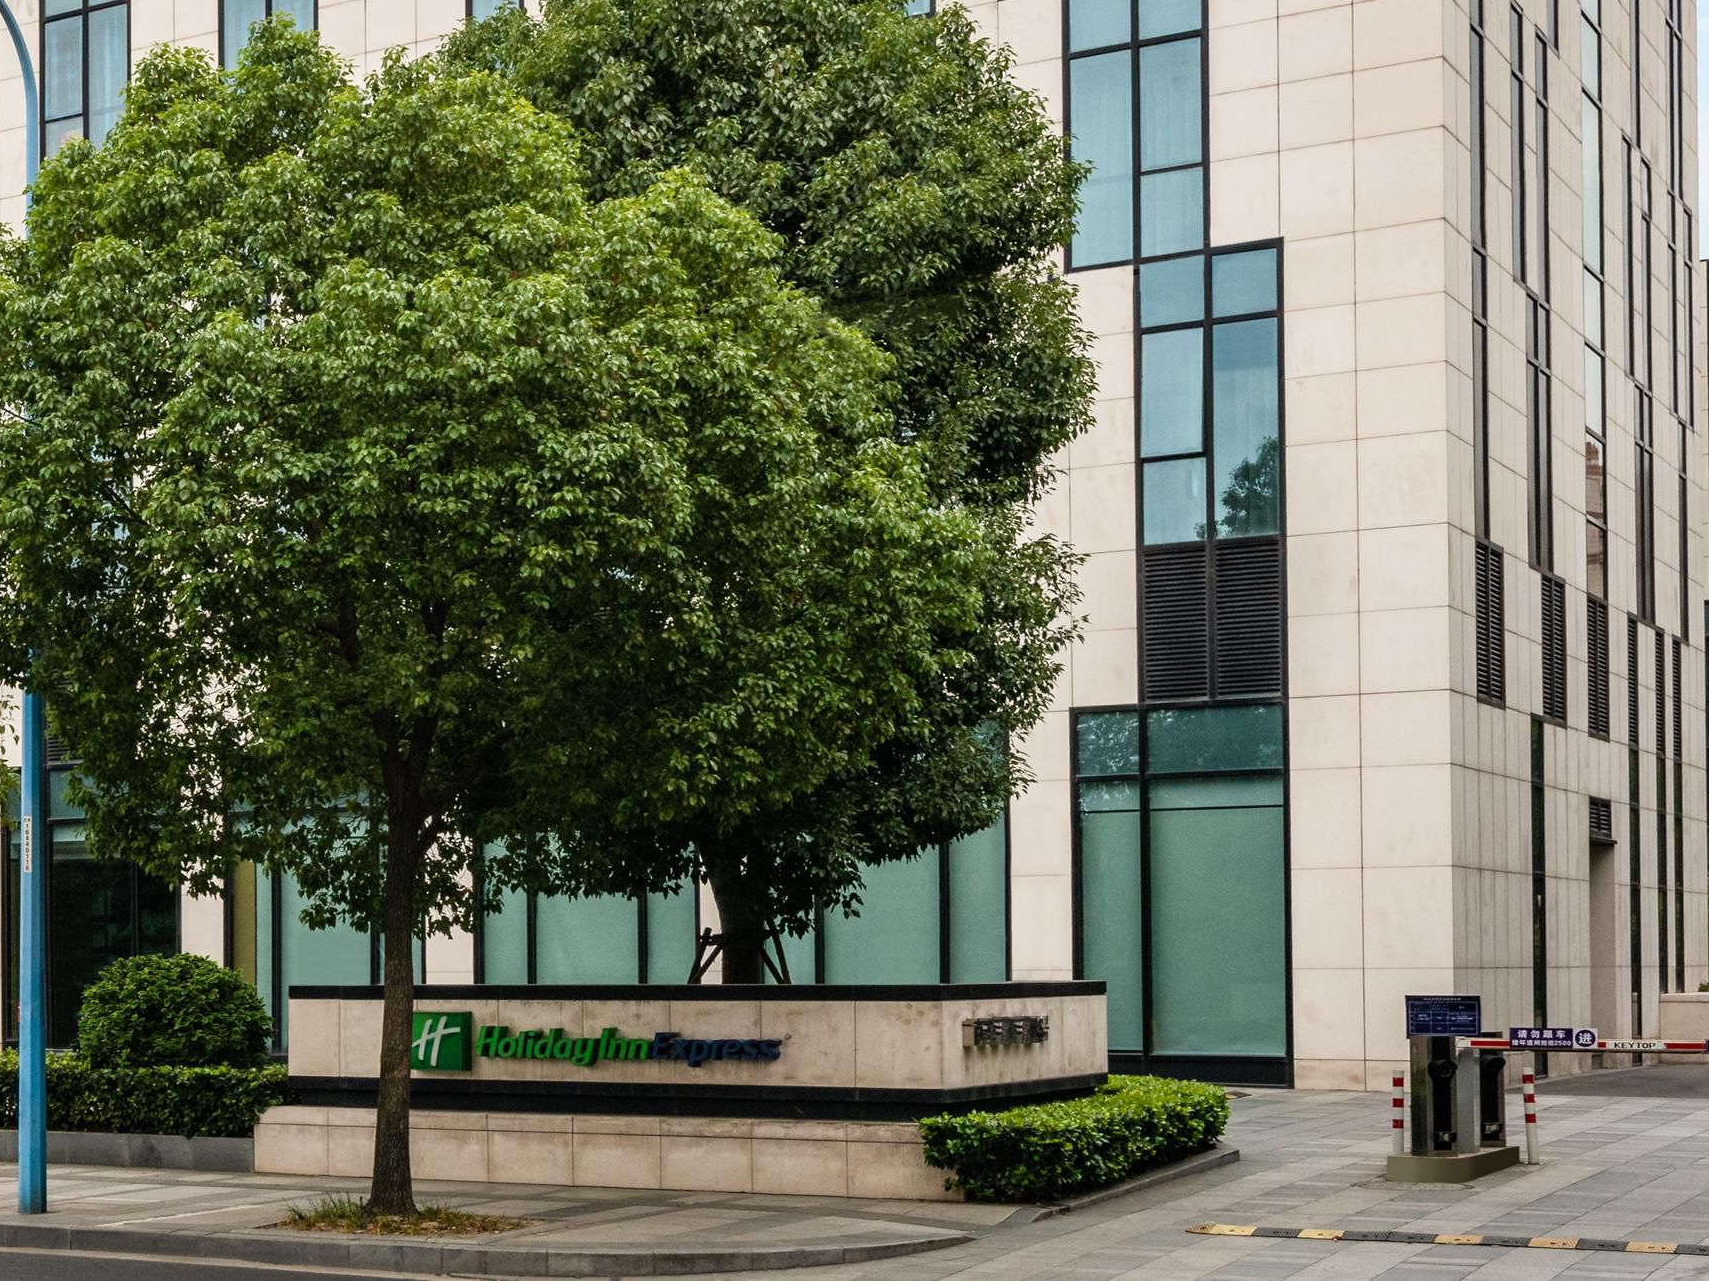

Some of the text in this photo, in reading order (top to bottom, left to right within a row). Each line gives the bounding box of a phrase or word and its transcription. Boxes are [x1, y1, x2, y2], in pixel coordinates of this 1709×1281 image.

[475, 1026, 595, 1067] Holiday
[596, 1027, 651, 1060] Inn
[651, 1031, 782, 1067] Express
[1578, 1032, 1593, 1045] 进
